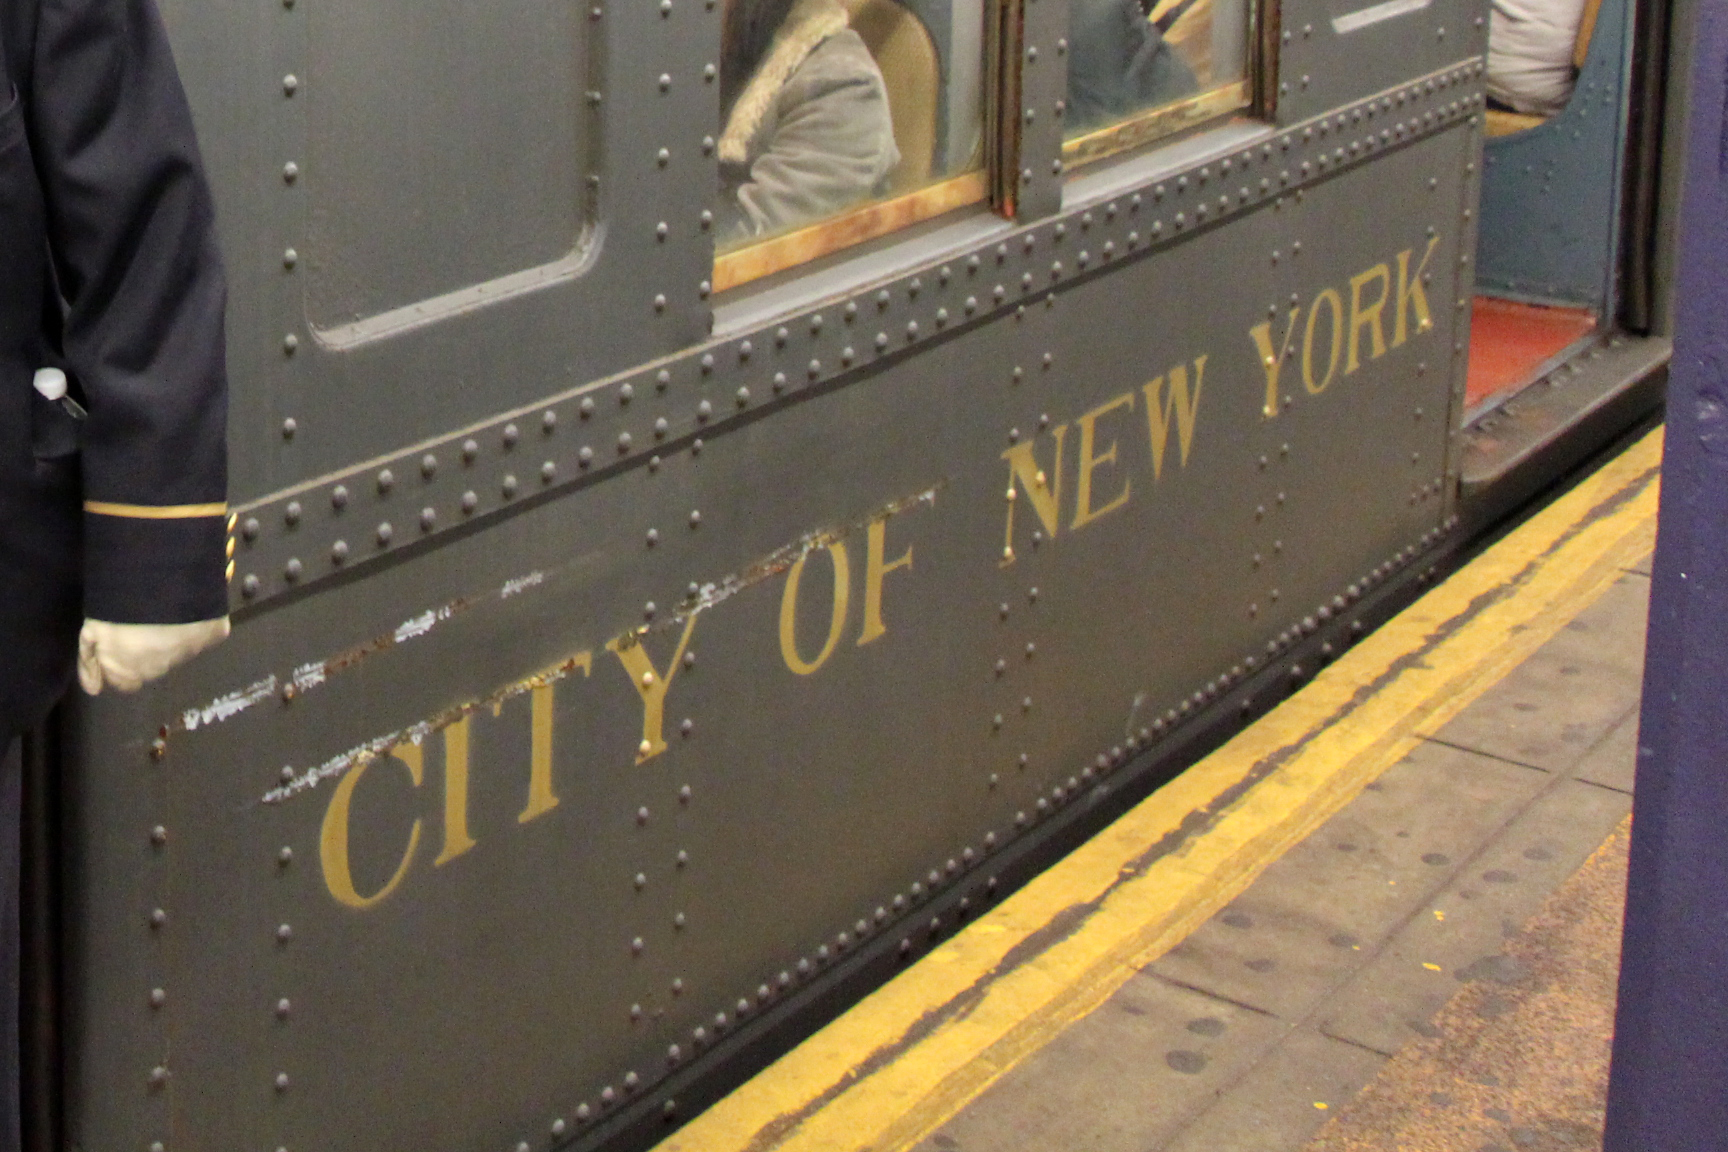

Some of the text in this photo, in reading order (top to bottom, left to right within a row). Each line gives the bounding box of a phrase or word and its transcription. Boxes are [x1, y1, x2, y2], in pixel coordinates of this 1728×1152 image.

[319, 235, 1439, 909] CITY OF NEW YORK
